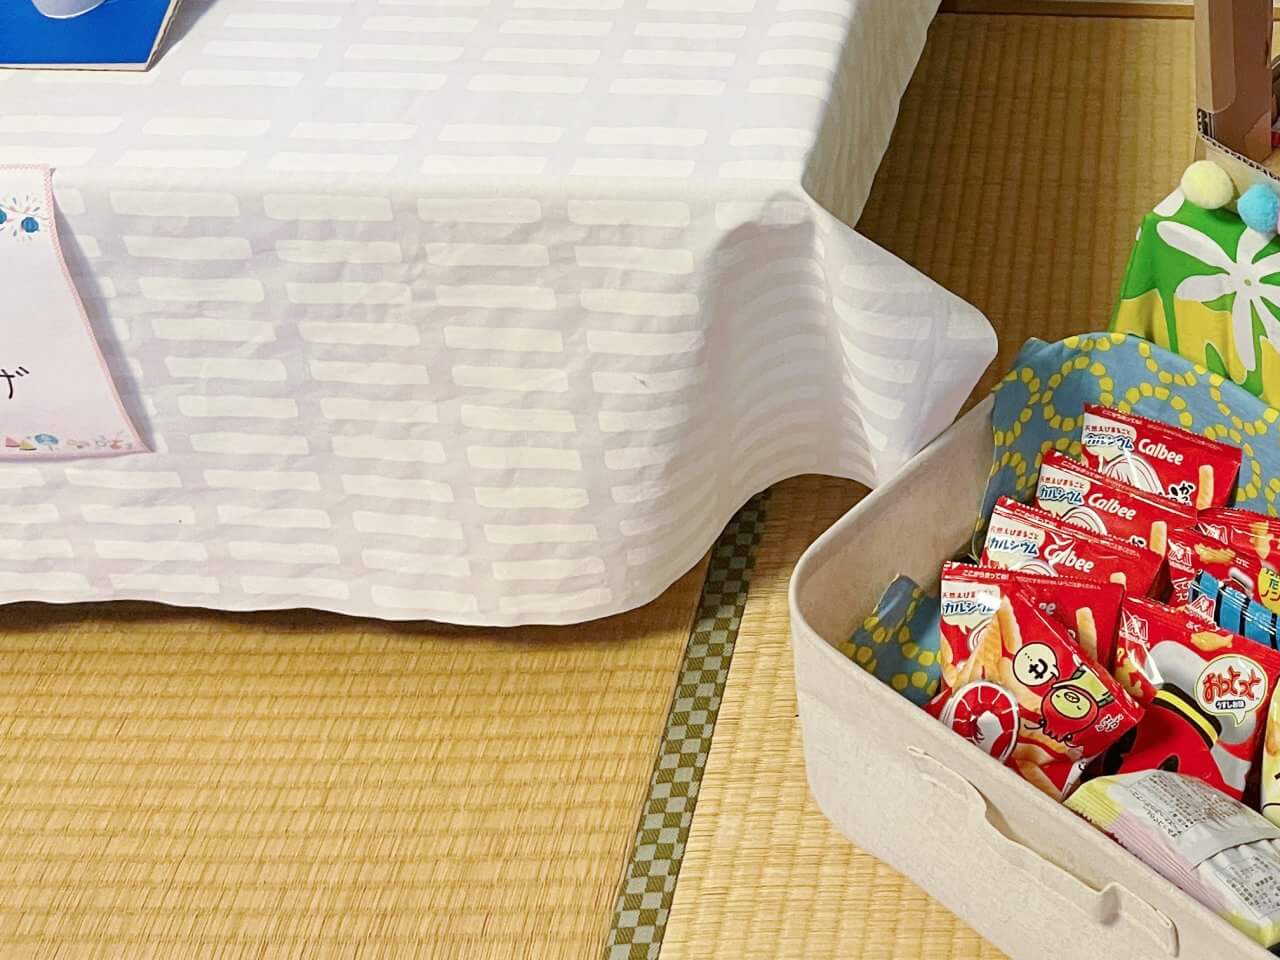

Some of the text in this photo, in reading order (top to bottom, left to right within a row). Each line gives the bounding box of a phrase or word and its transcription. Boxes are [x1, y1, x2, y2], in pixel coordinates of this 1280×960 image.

[1138, 437, 1185, 466] Calbee
[1087, 492, 1137, 521] Calbee
[988, 536, 1040, 557] カルシウム
[1043, 543, 1095, 573] Calbee
